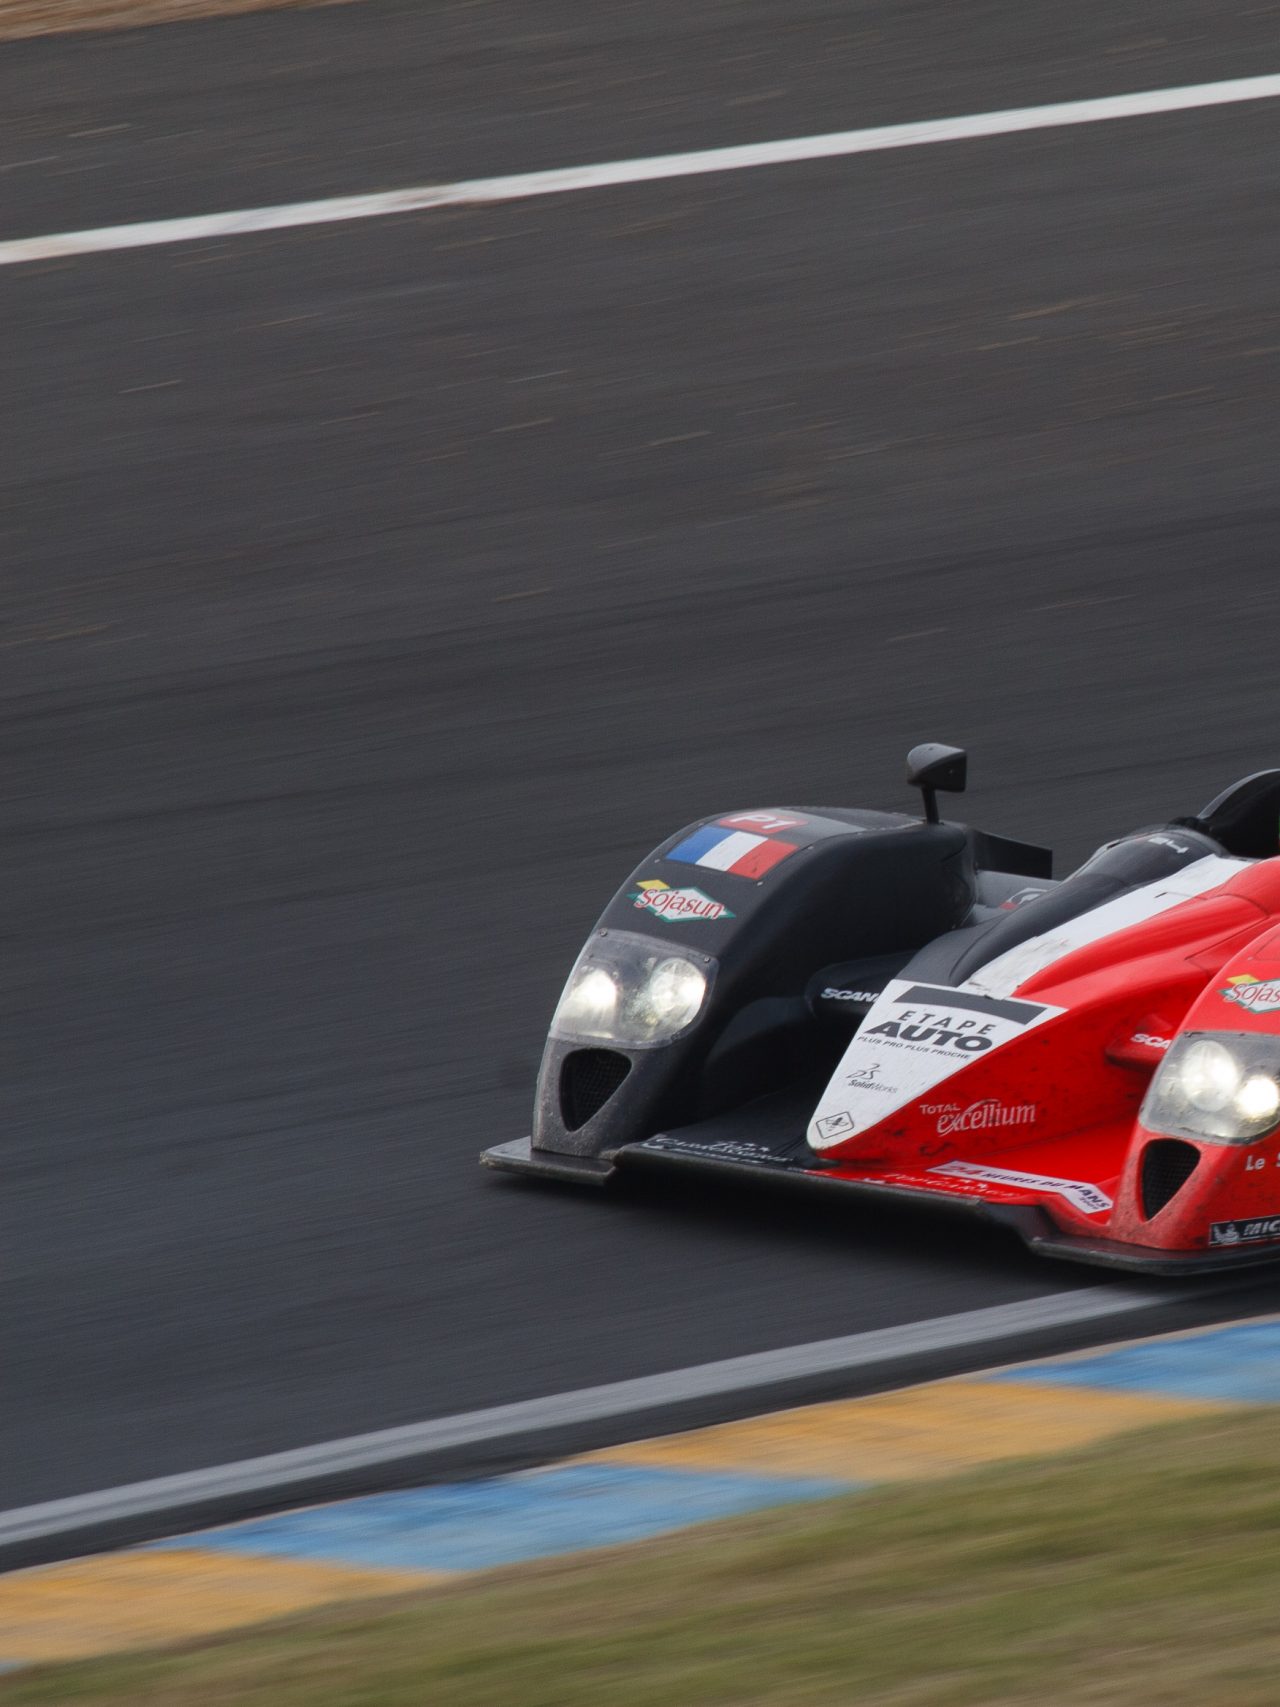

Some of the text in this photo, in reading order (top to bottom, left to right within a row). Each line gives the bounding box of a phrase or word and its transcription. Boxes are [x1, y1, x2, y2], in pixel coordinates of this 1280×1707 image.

[820, 987, 880, 1003] SCAN
[898, 1010, 997, 1035] ETAPE
[864, 1021, 993, 1051] AUTO
[1129, 1033, 1173, 1050] SCA
[857, 1036, 972, 1060] PLUS PRO PLUS PROCHE
[919, 1103, 961, 1114] TOTAL
[937, 1099, 1036, 1137] excellium
[1245, 1154, 1265, 1171] Le
